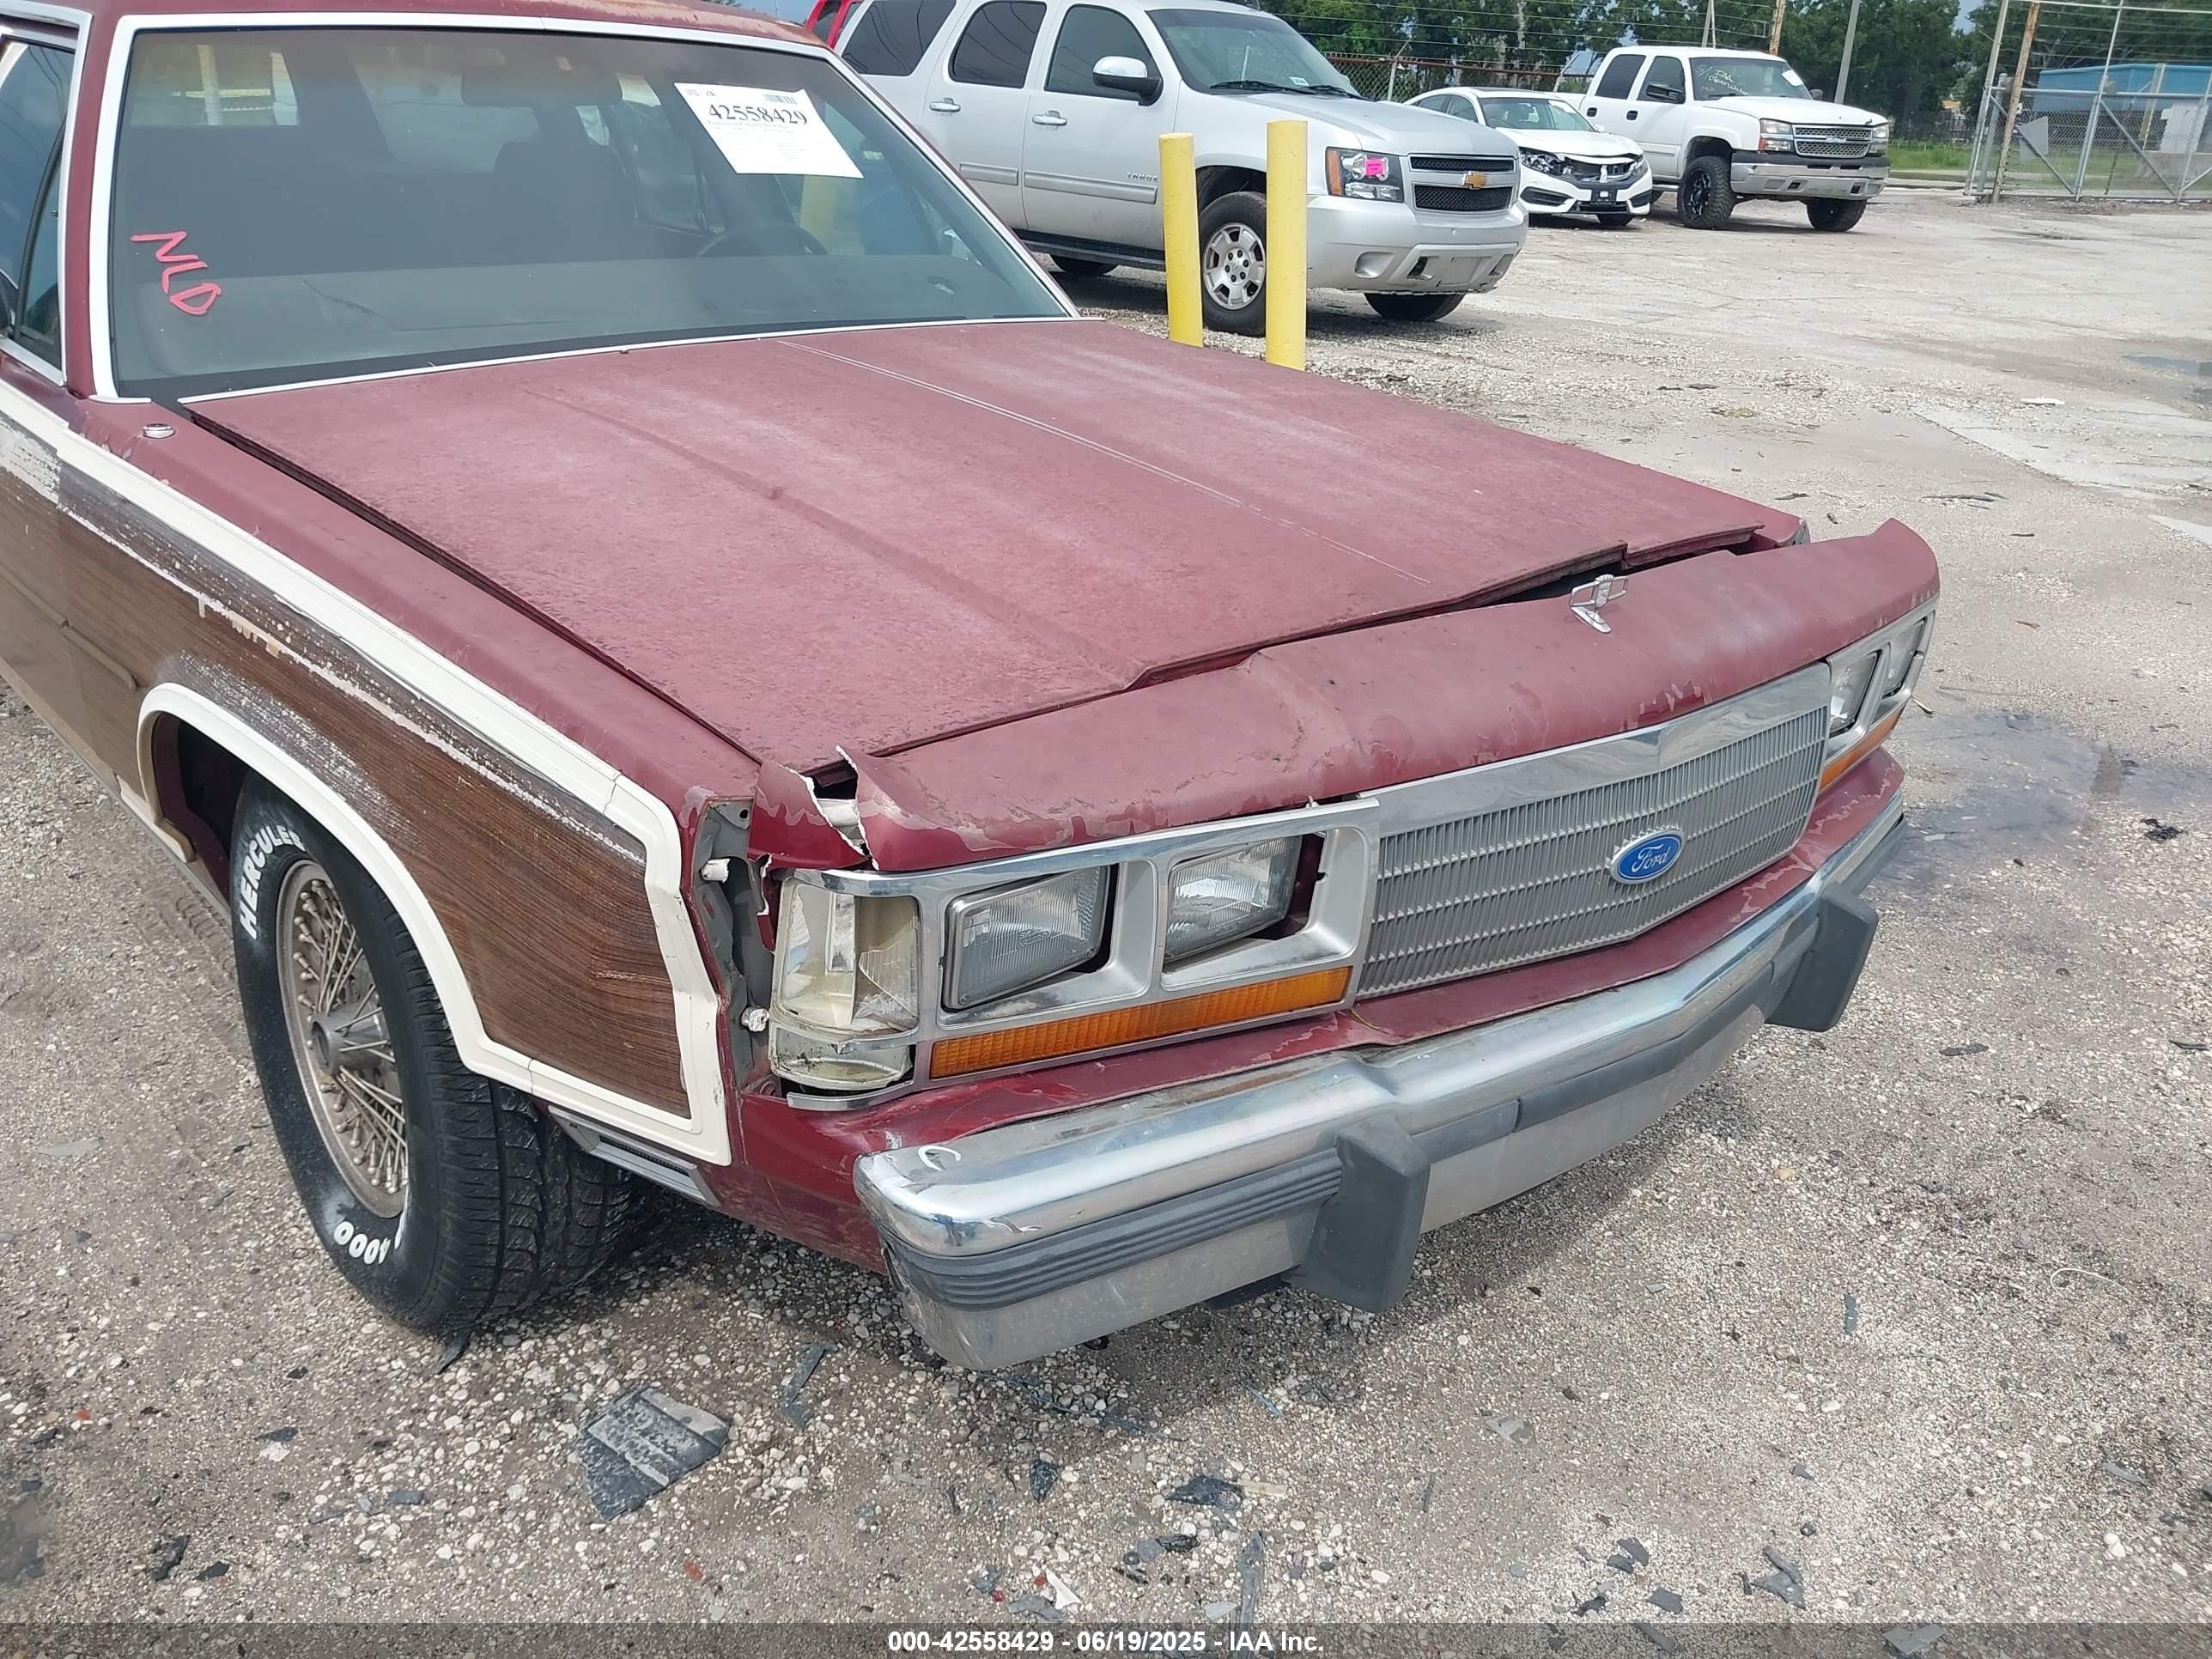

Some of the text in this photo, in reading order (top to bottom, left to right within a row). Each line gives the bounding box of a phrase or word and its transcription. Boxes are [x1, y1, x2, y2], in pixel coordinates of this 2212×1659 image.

[708, 103, 808, 125] 42558429
[1631, 842, 1673, 873] Ford
[240, 824, 307, 940] HERCULES
